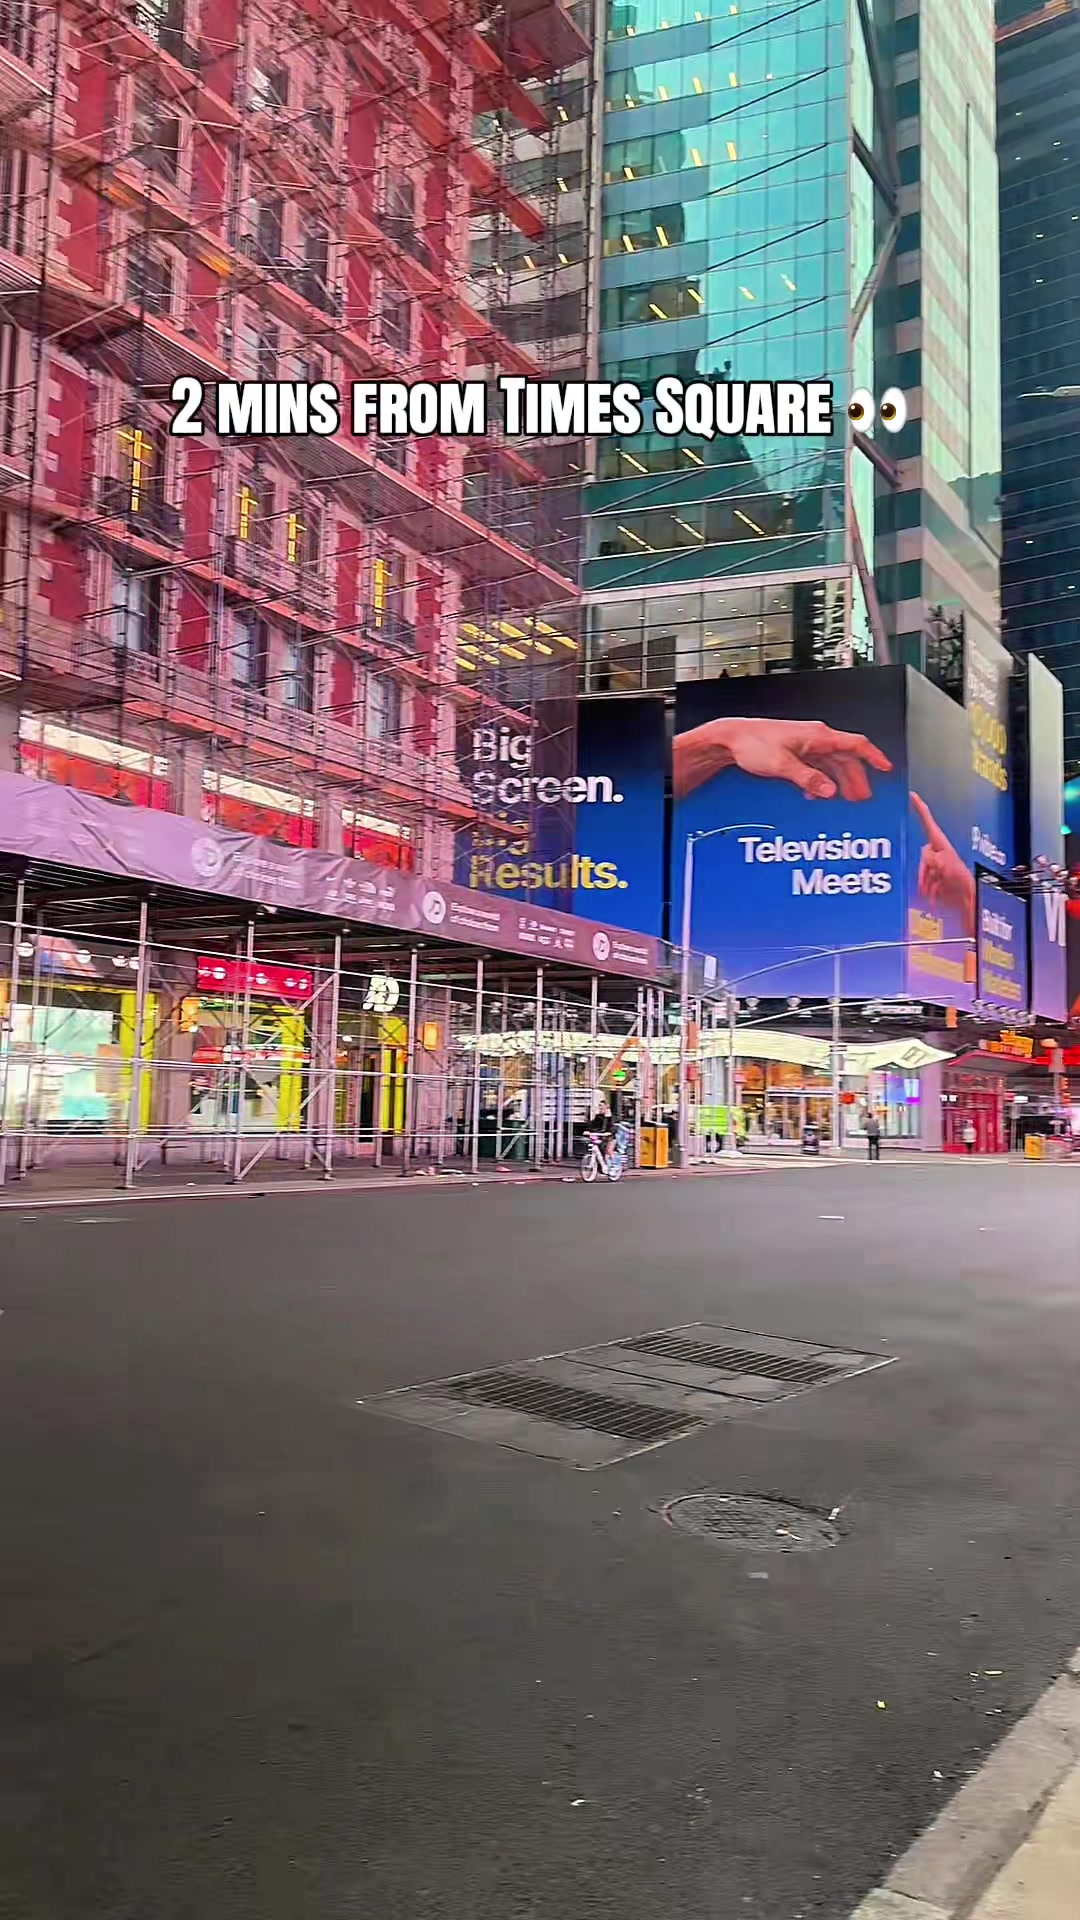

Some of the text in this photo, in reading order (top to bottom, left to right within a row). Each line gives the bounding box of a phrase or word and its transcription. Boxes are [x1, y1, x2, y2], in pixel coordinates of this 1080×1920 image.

[472, 726, 533, 770] Big
[472, 769, 625, 804] Screen.
[471, 811, 530, 856] ig
[737, 831, 892, 863] Television
[469, 853, 629, 890] Results.
[791, 868, 892, 896] Meets
